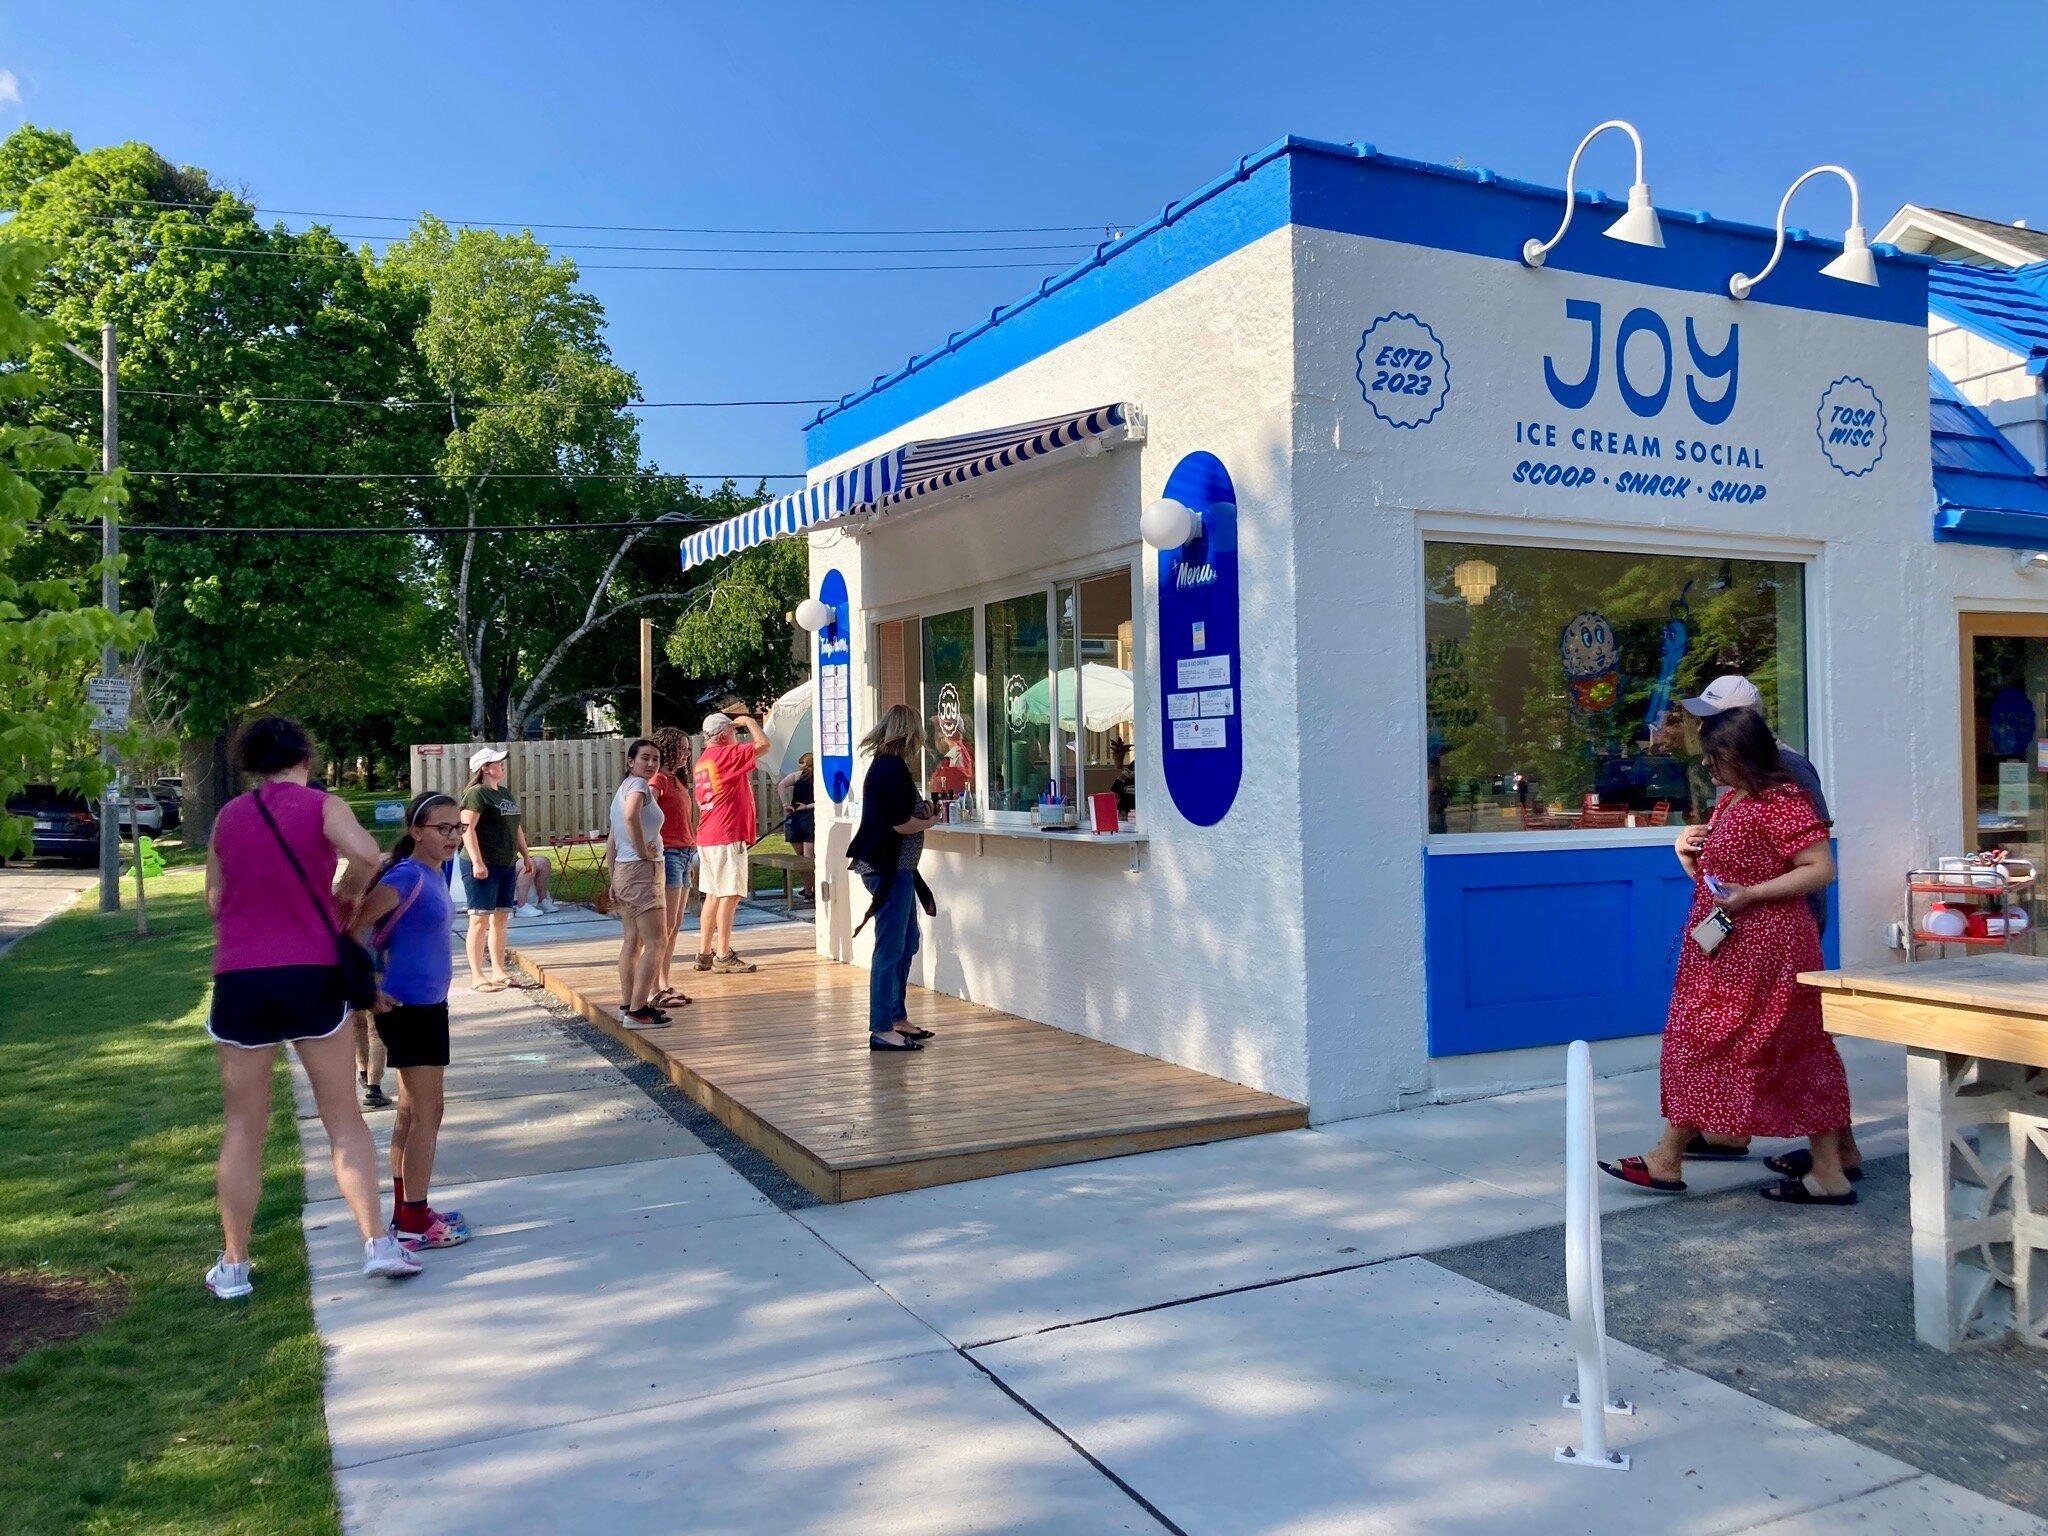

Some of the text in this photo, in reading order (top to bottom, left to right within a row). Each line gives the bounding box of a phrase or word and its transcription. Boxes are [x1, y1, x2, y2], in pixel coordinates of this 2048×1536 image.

[1375, 346, 1433, 372] ESTD
[1543, 298, 1740, 426] JOY
[1371, 370, 1432, 396] 2023
[1830, 405, 1876, 428] TOSA
[1516, 421, 1764, 469] ICE CREAM SOCIAL
[1828, 427, 1875, 447] WISC
[1512, 460, 1767, 505] SCOOP SNACK SHOP
[1176, 562, 1213, 588] Menu
[940, 701, 958, 720] JOY
